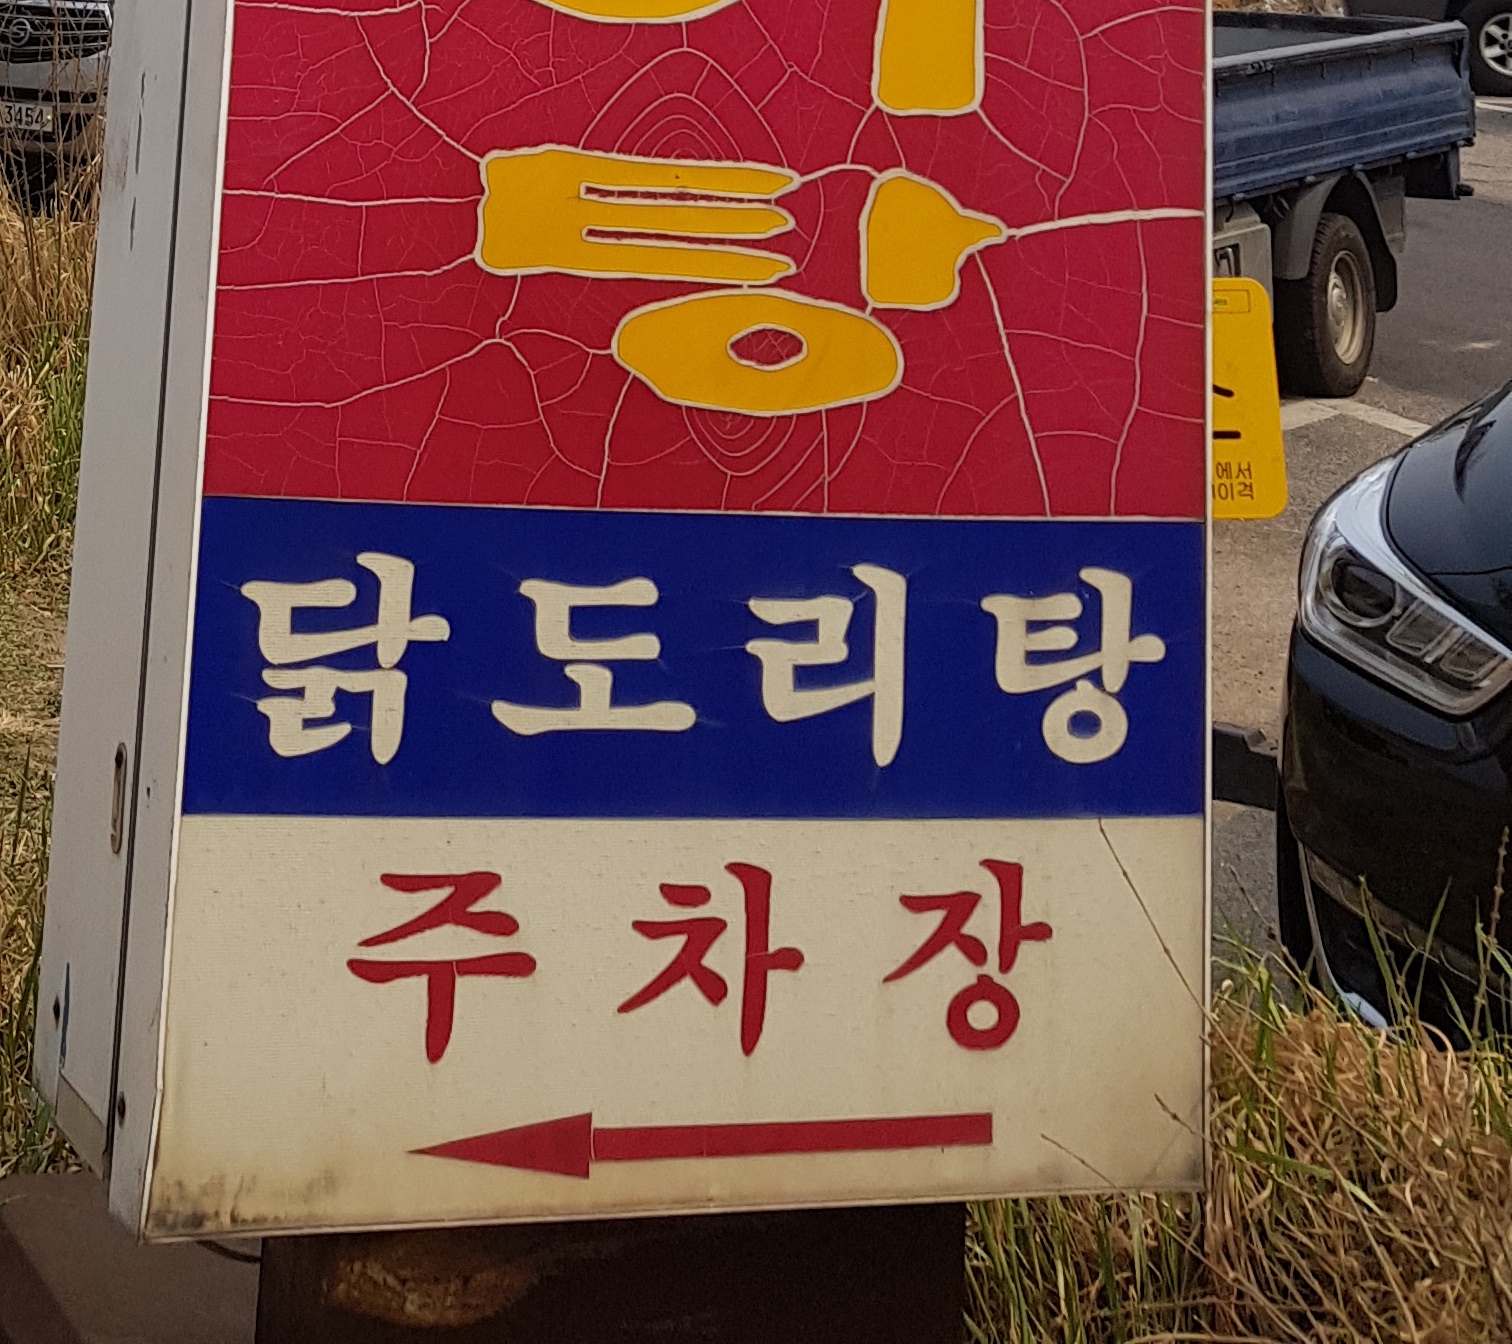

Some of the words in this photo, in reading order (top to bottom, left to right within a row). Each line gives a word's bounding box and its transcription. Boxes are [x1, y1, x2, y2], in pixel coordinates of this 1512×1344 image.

[1212, 482, 1254, 501] 이격
[240, 551, 1167, 768] 닭도리탕
[345, 858, 1054, 1065] 주차장
